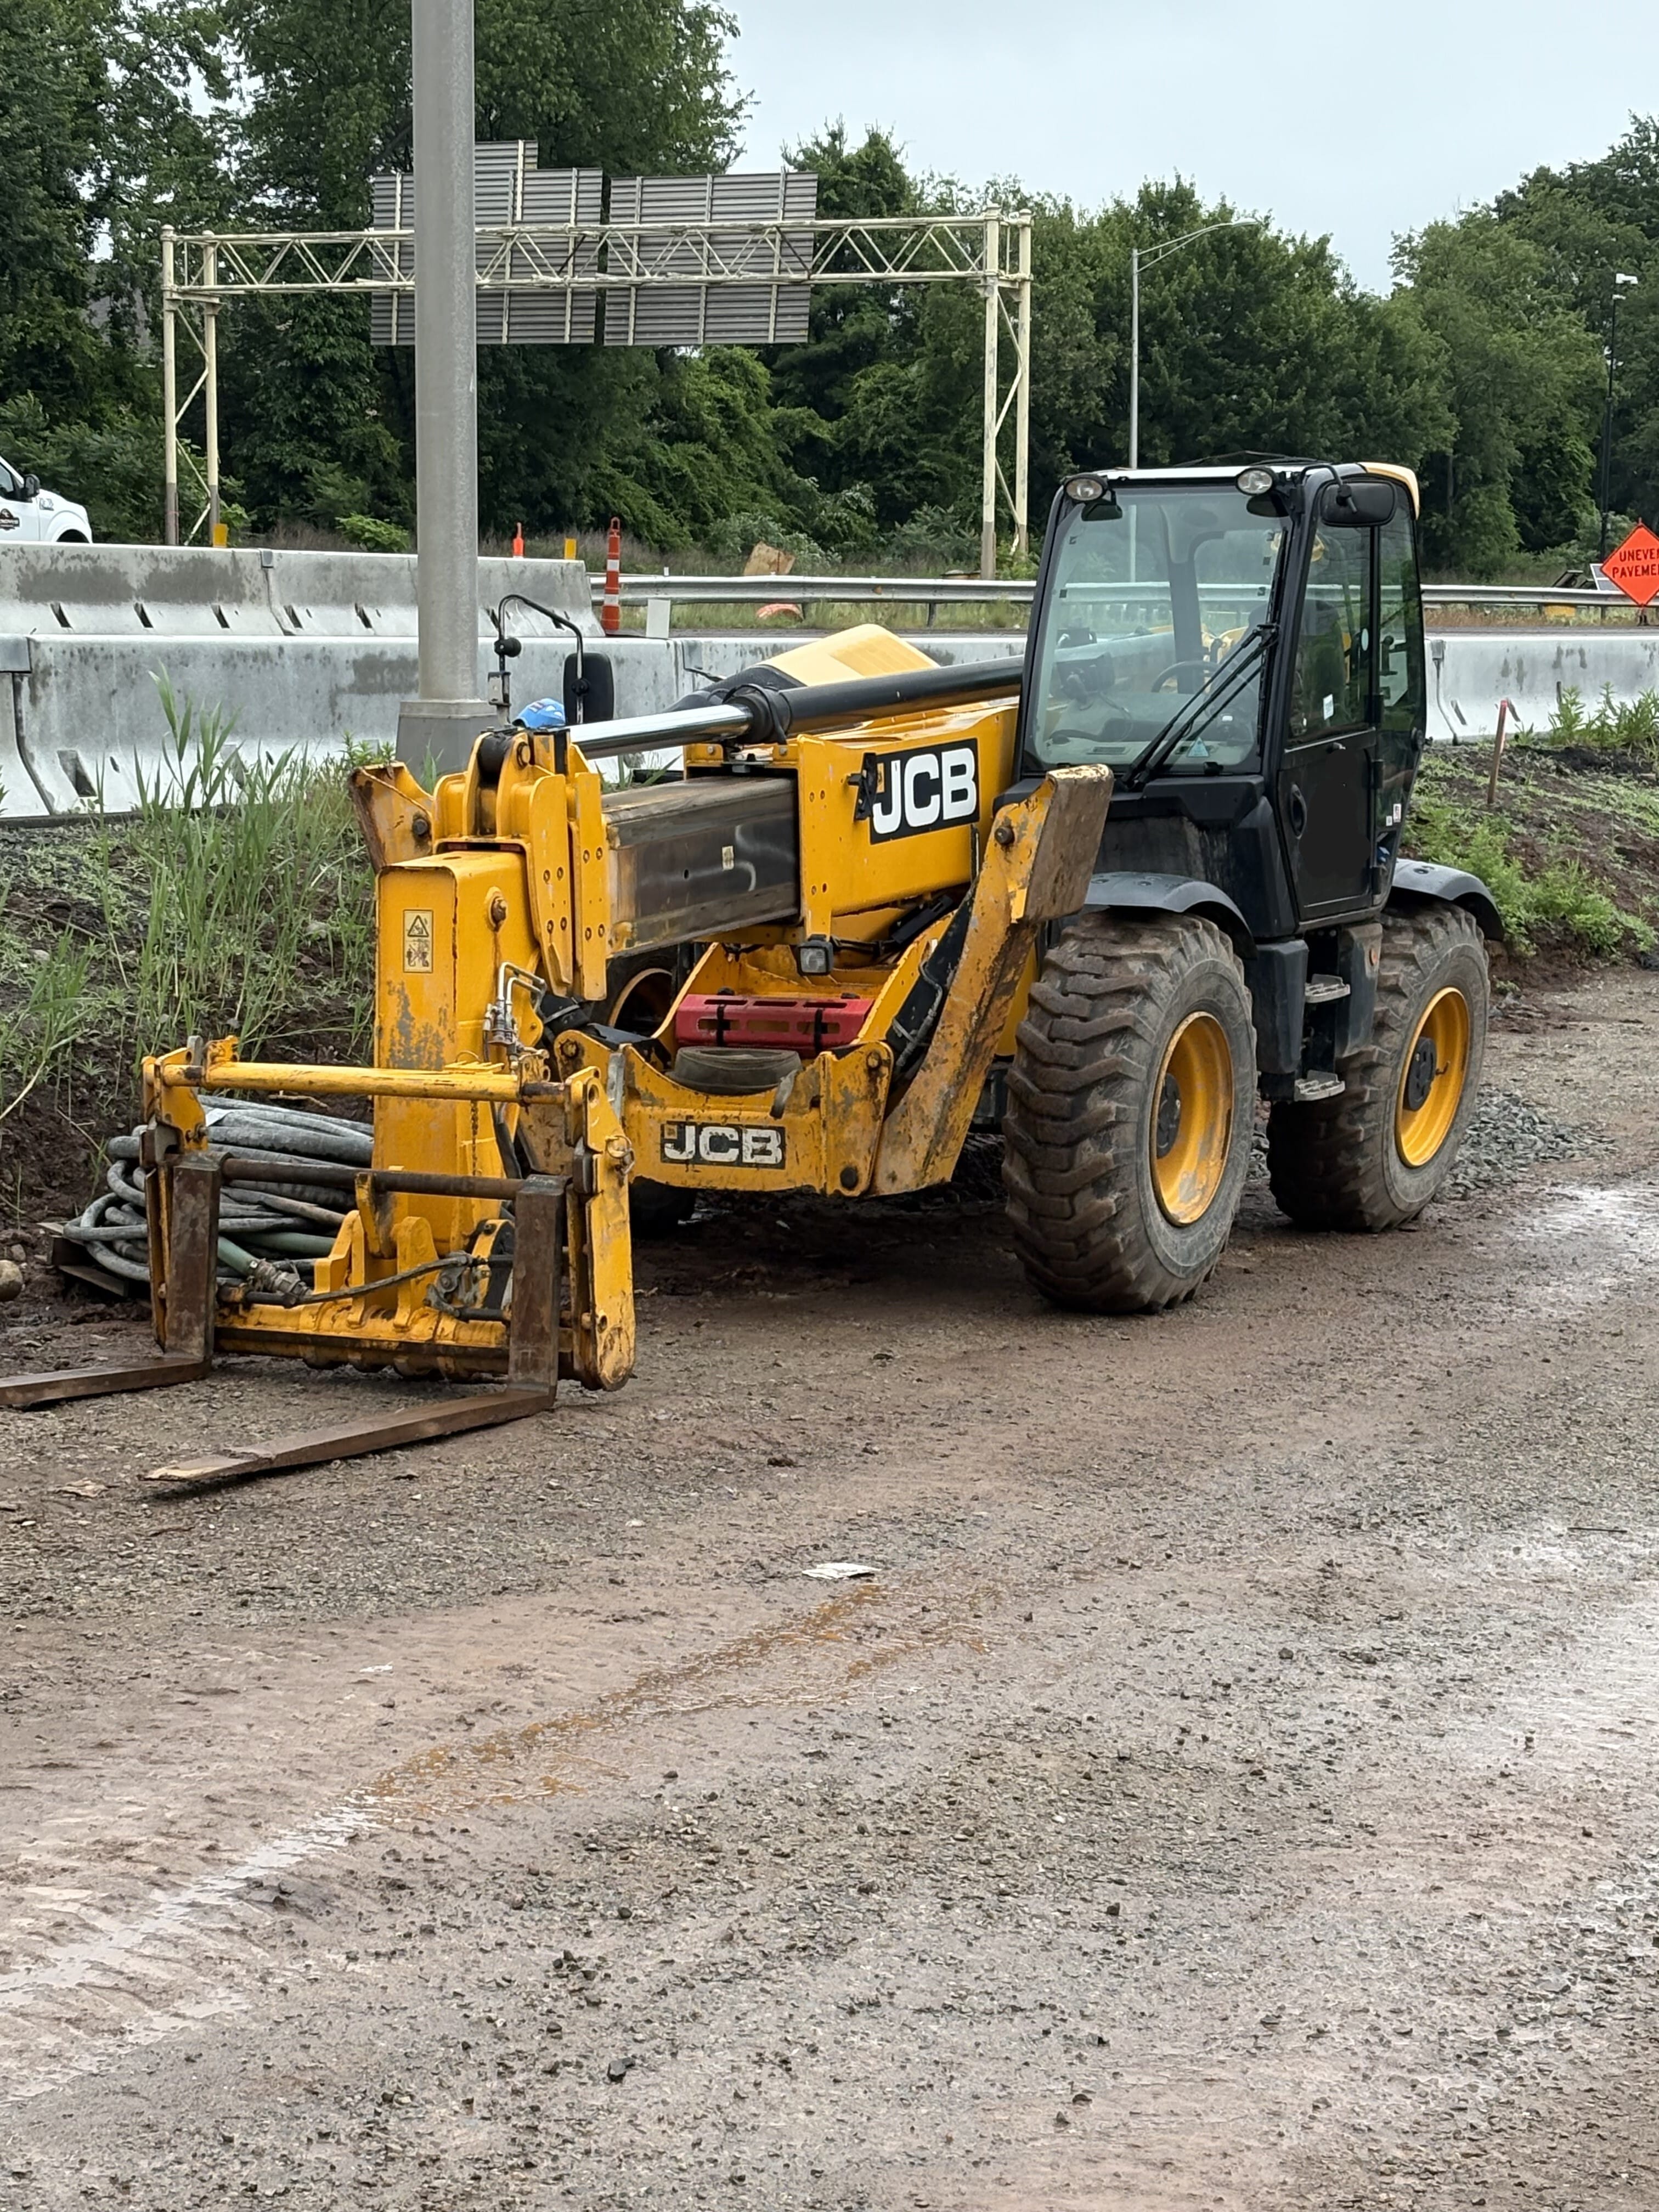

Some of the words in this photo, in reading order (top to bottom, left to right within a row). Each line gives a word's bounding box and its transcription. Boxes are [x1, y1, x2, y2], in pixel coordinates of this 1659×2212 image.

[1612, 563, 1659, 579] PAVEME
[872, 747, 977, 834] JCB
[664, 1125, 782, 1165] JCB
